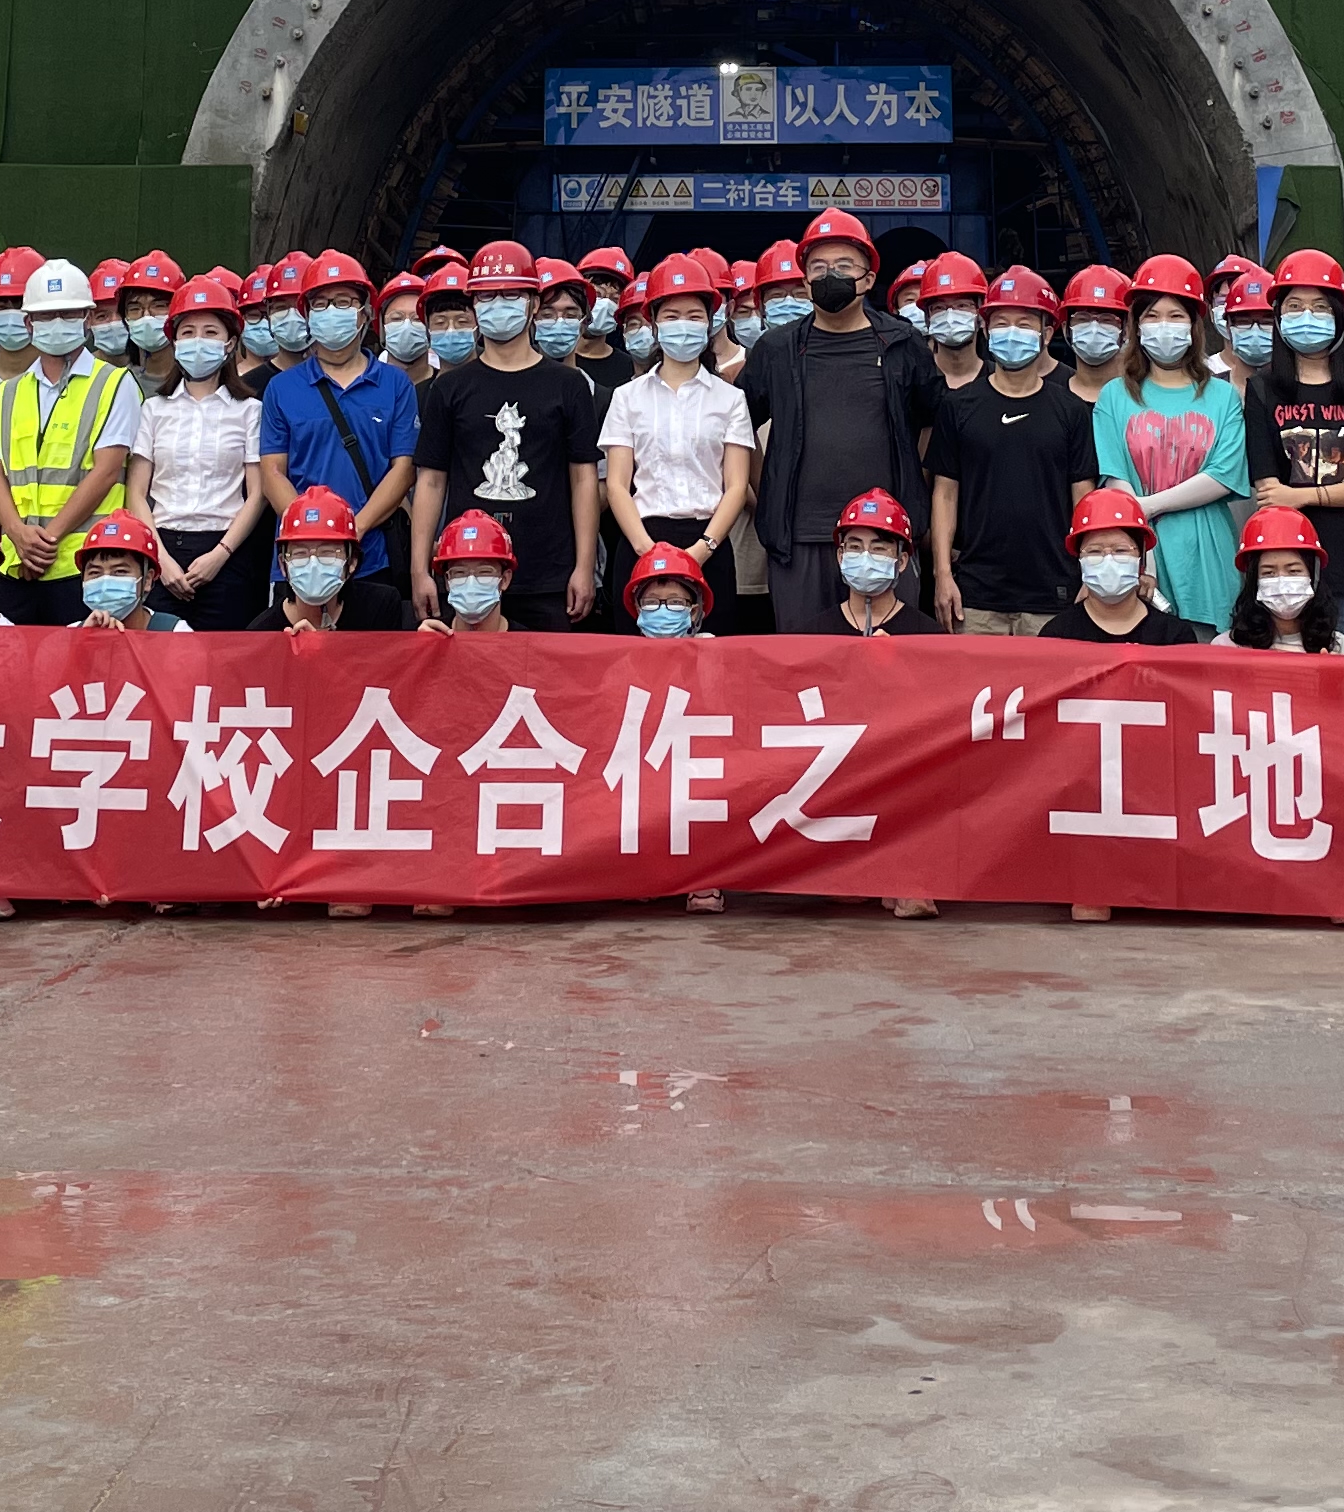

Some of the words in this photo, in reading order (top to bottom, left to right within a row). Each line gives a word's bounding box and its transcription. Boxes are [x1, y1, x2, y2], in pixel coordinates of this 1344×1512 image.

[555, 82, 714, 128] 平安隧道
[784, 81, 943, 128] 以人为本
[700, 179, 802, 207] 二衬台车
